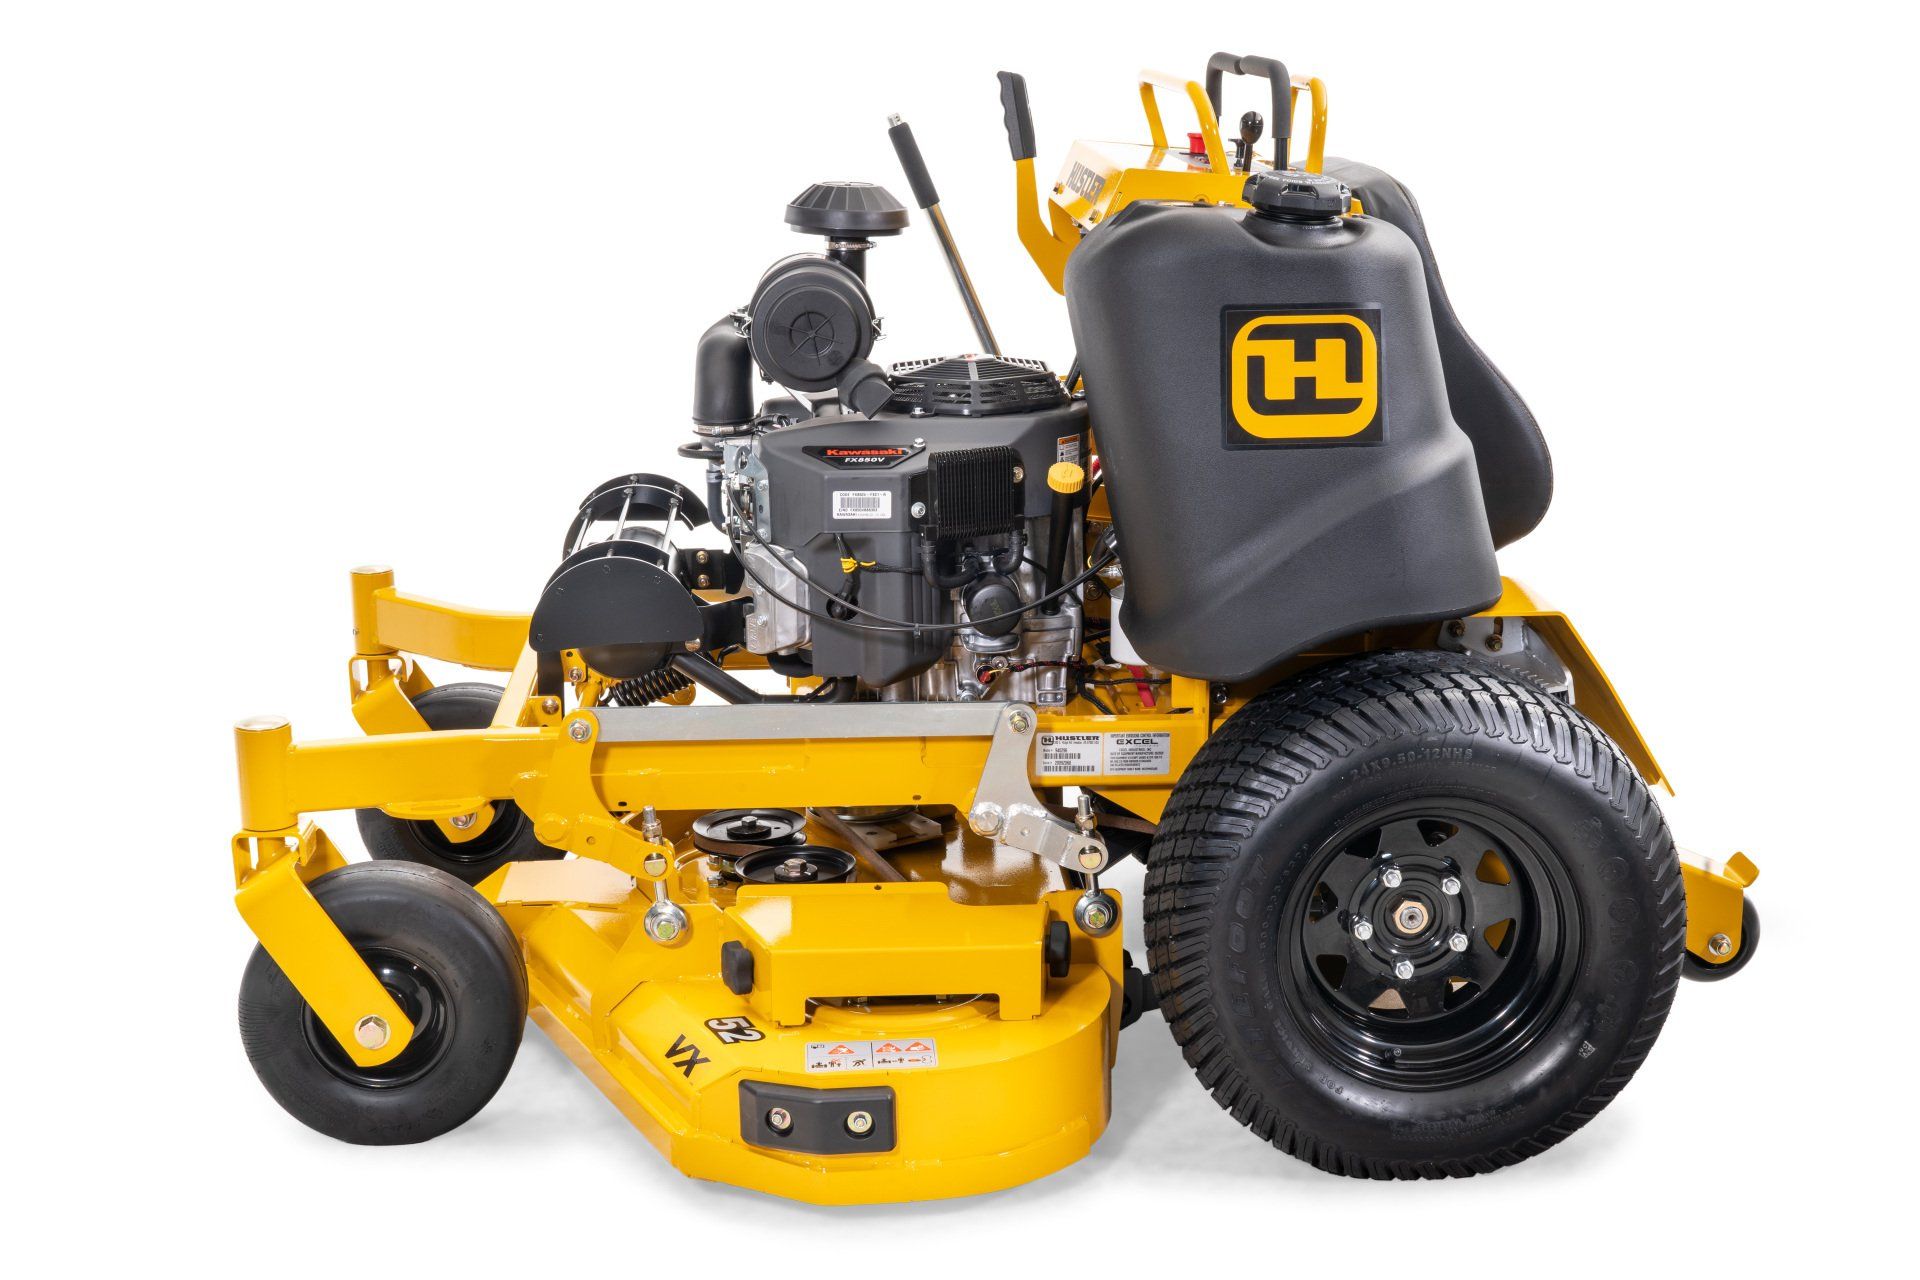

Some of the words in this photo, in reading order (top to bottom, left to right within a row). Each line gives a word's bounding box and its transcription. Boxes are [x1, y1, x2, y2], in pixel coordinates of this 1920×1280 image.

[826, 448, 903, 456] Kawasaki
[705, 1016, 766, 1045] 52
[664, 1033, 711, 1079] VX
